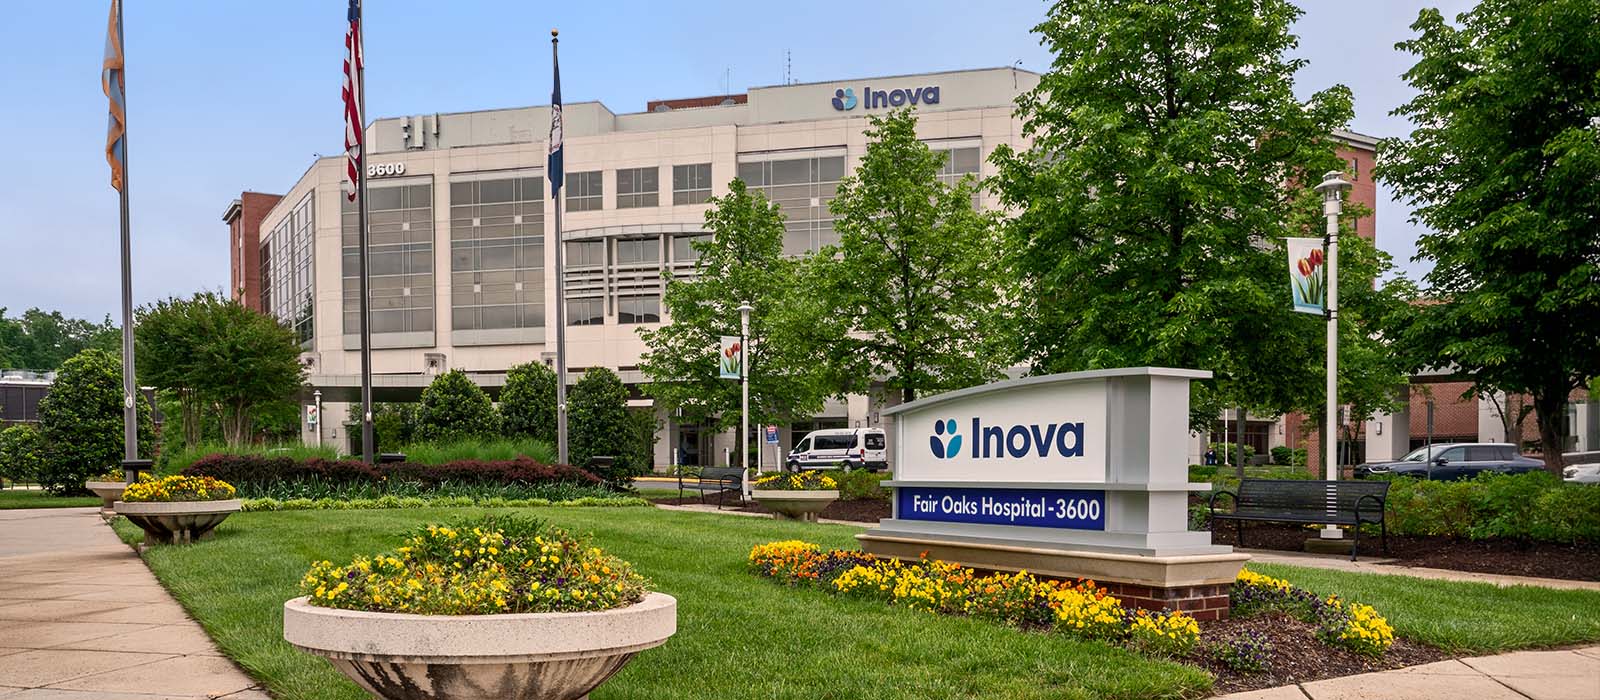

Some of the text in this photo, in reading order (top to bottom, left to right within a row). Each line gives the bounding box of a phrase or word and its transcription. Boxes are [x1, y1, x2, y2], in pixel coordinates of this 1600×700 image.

[864, 86, 940, 109] Inova
[368, 162, 405, 176] 3600
[972, 417, 1084, 458] Inova
[913, 495, 938, 513] Fair
[941, 495, 978, 515] Oaks
[982, 496, 1045, 521] Hospital
